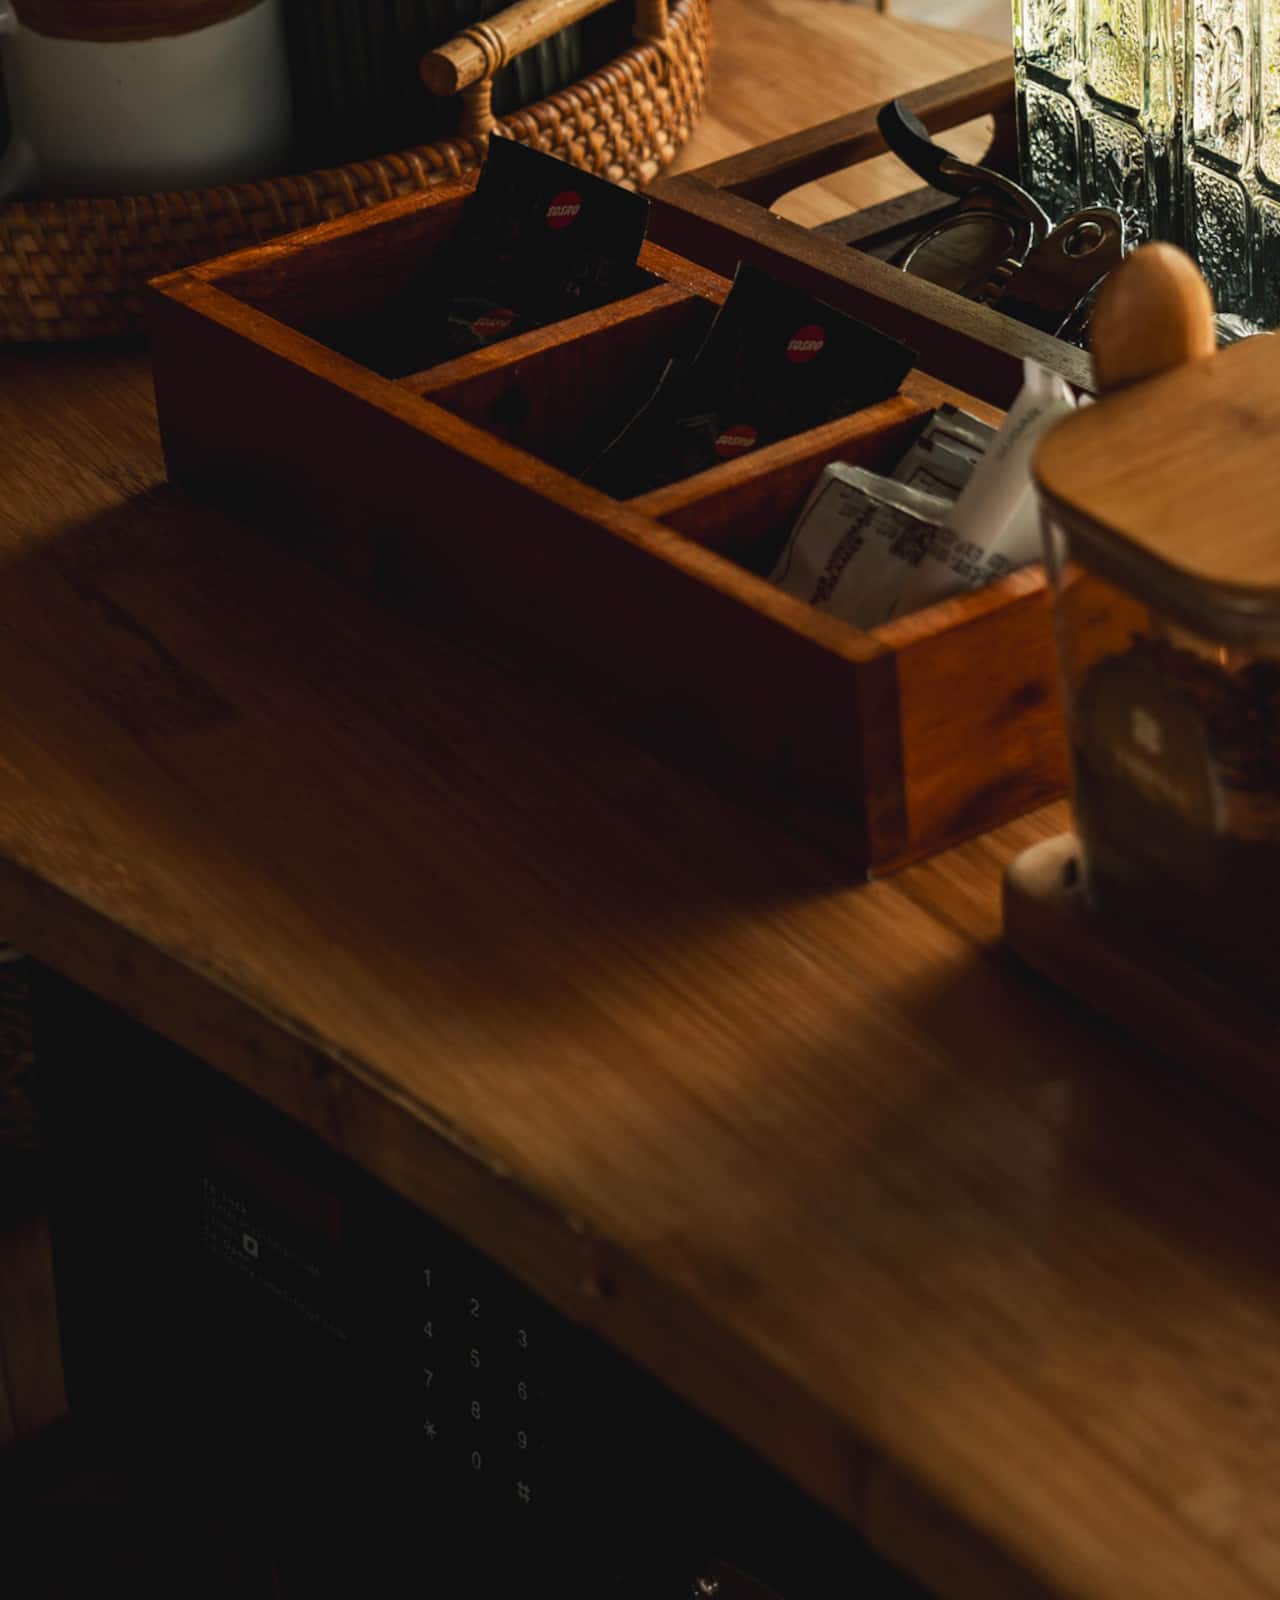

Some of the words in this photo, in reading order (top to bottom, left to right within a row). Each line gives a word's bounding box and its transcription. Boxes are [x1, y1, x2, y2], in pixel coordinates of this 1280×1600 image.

[423, 1268, 432, 1288] 1
[469, 1297, 481, 1318] 2
[517, 1329, 529, 1349] 3
[423, 1321, 433, 1339] 4
[470, 1348, 481, 1369] 5
[517, 1381, 529, 1401] 6
[423, 1369, 434, 1387] 7
[470, 1400, 482, 1420] 8
[517, 1430, 528, 1449] 9
[471, 1451, 482, 1471] 0
